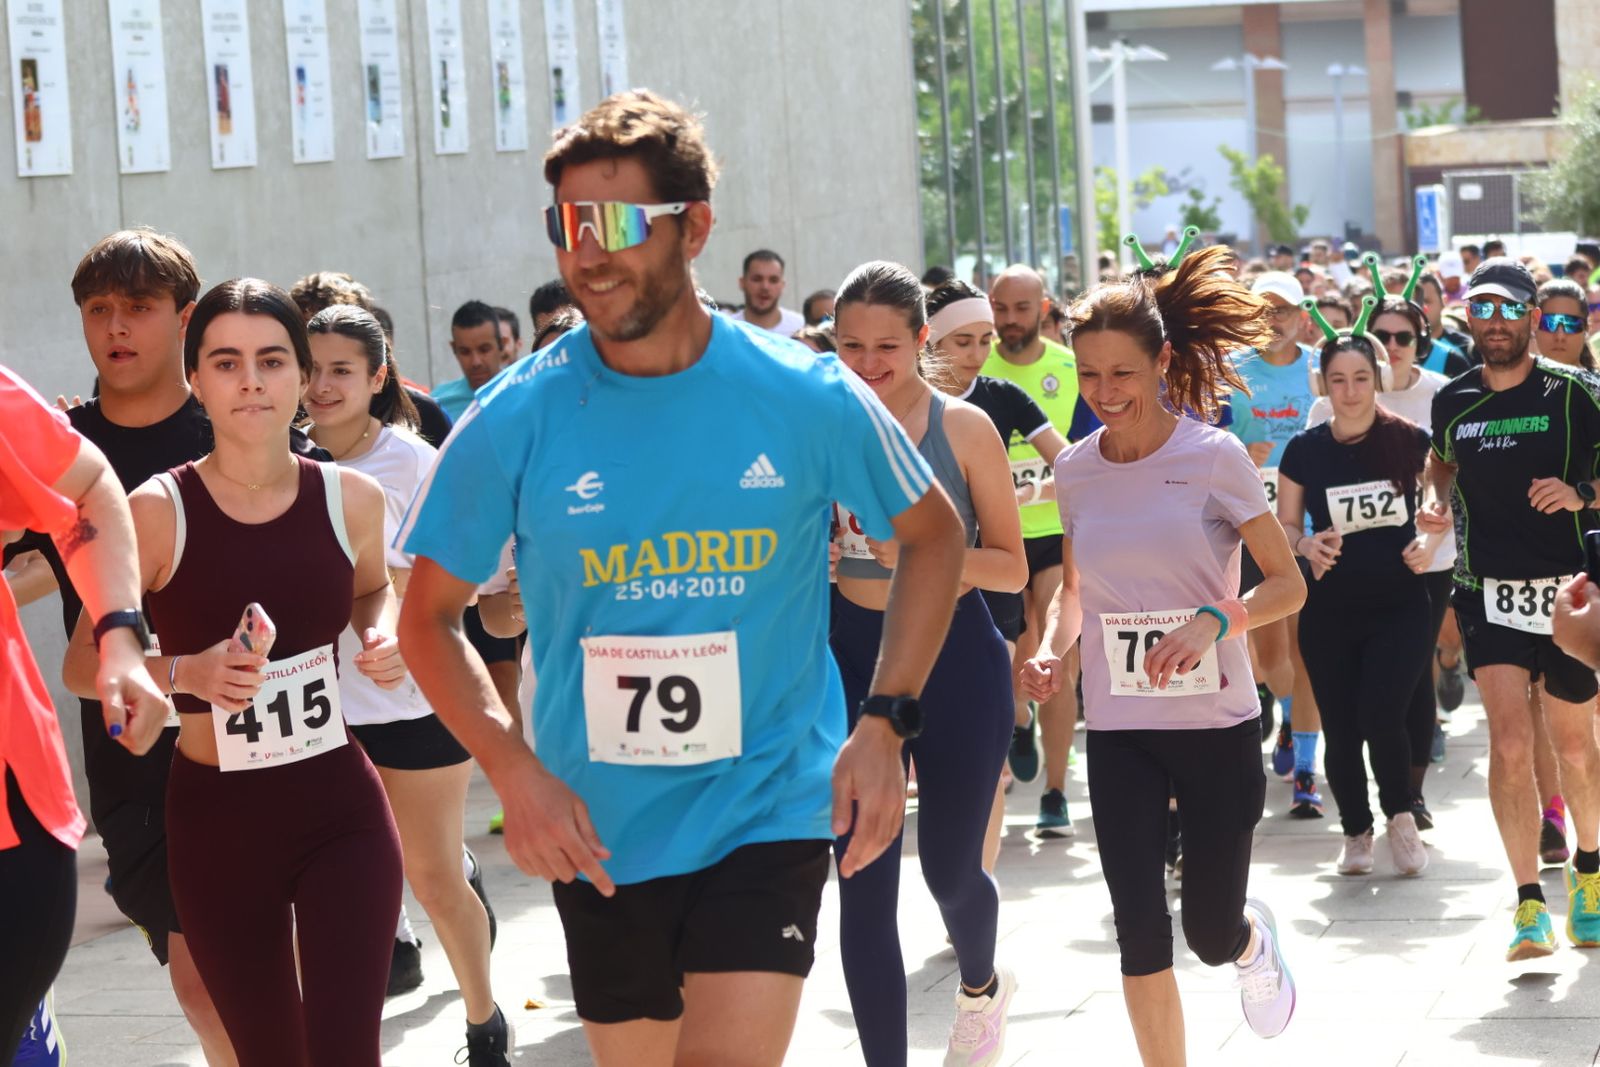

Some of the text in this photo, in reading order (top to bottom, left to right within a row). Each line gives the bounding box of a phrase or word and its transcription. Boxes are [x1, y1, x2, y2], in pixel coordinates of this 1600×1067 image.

[739, 476, 785, 489] adidas
[1338, 490, 1397, 523] 752
[579, 528, 778, 587] MADRID
[1496, 583, 1558, 618] 838
[1105, 616, 1120, 626] DÍA
[1121, 617, 1132, 626] DE
[1133, 615, 1174, 626] CASTILLA
[1175, 615, 1182, 623] Y
[298, 663, 305, 672] Y
[305, 655, 328, 670] LEÓN
[588, 643, 728, 660] DÍA DE CASTILLA Y LEÓN
[226, 678, 331, 743] 415
[617, 674, 701, 734] 79
